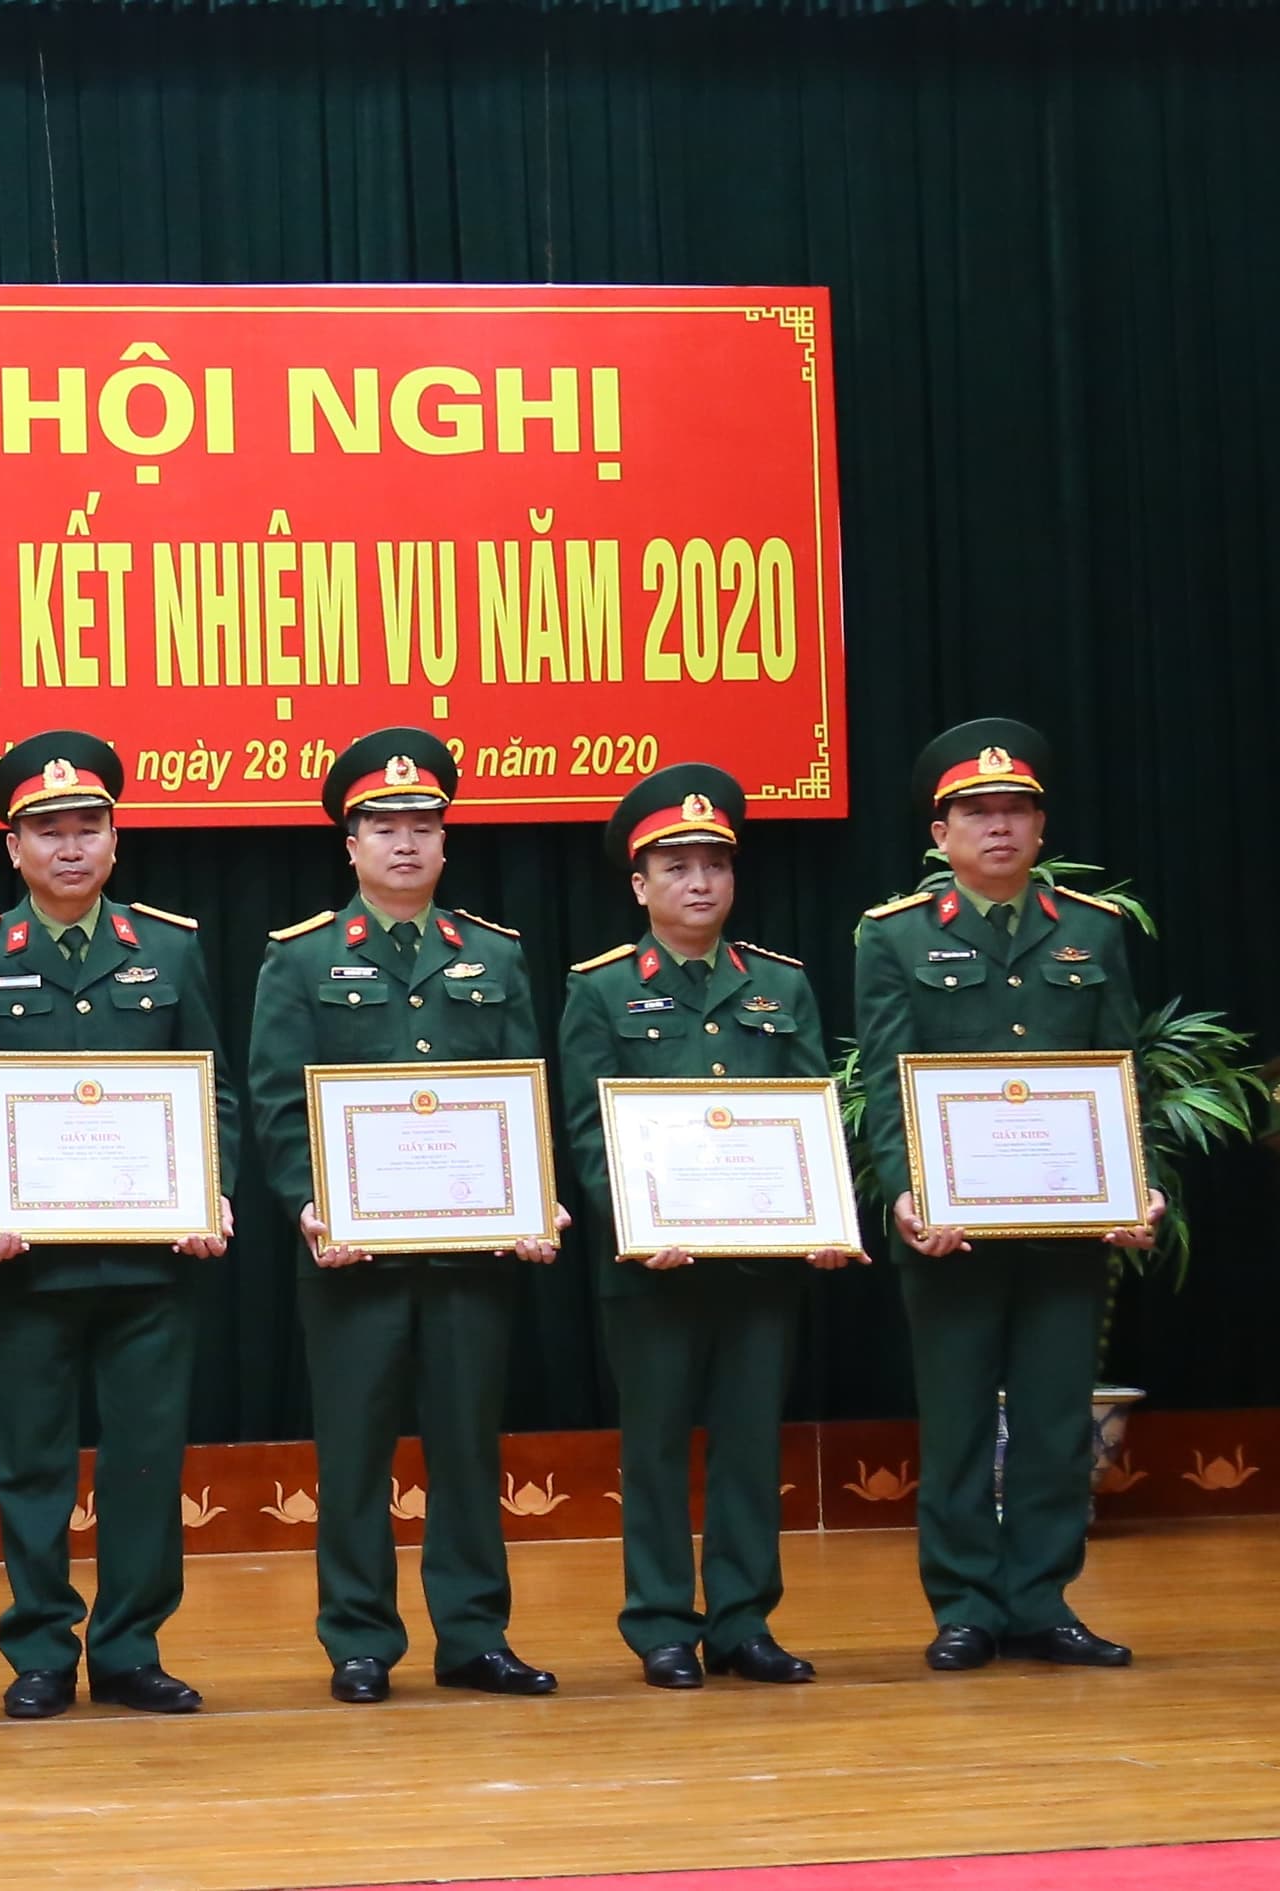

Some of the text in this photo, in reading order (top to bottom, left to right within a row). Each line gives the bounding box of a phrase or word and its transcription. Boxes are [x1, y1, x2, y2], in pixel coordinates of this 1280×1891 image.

[1, 341, 621, 485] HỘI NGHỊ
[18, 491, 133, 688] KẾT
[152, 508, 360, 721] NHIỆM
[376, 540, 458, 719] VỤ
[477, 507, 623, 684] NĂM
[642, 537, 797, 683] 2020
[136, 739, 233, 791] ngày
[243, 739, 288, 780] 28
[476, 736, 557, 778] năm
[570, 734, 658, 775] 2020
